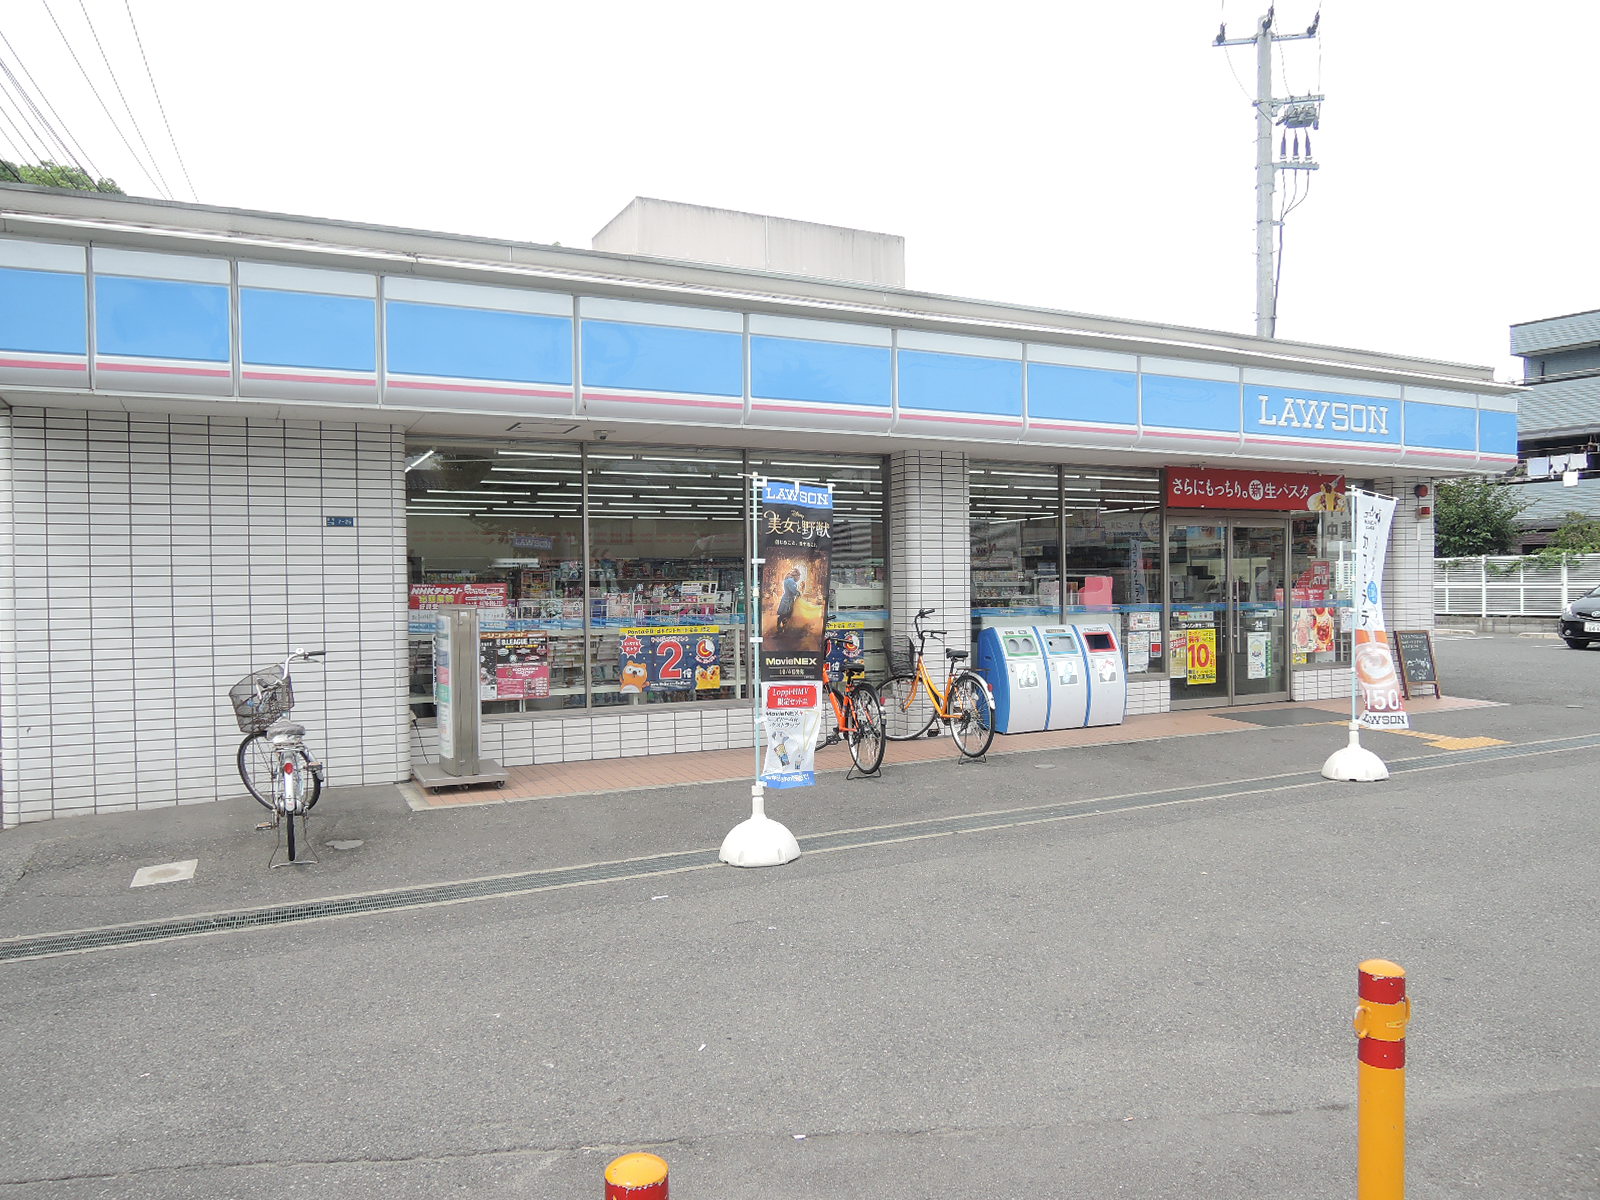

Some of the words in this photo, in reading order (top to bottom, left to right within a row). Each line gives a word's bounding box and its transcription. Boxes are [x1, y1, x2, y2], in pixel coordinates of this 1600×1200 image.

[1258, 394, 1389, 435] LAWSON
[766, 487, 829, 505] LAWSON
[764, 510, 831, 540] 美女と野獣
[411, 587, 463, 595] NHKテキスト
[656, 639, 683, 679] 2
[765, 656, 817, 666] MovieNEX
[1187, 643, 1210, 668] 10
[682, 668, 692, 678] 倍
[1365, 689, 1399, 710] 150
[1362, 713, 1406, 724] LWSON
